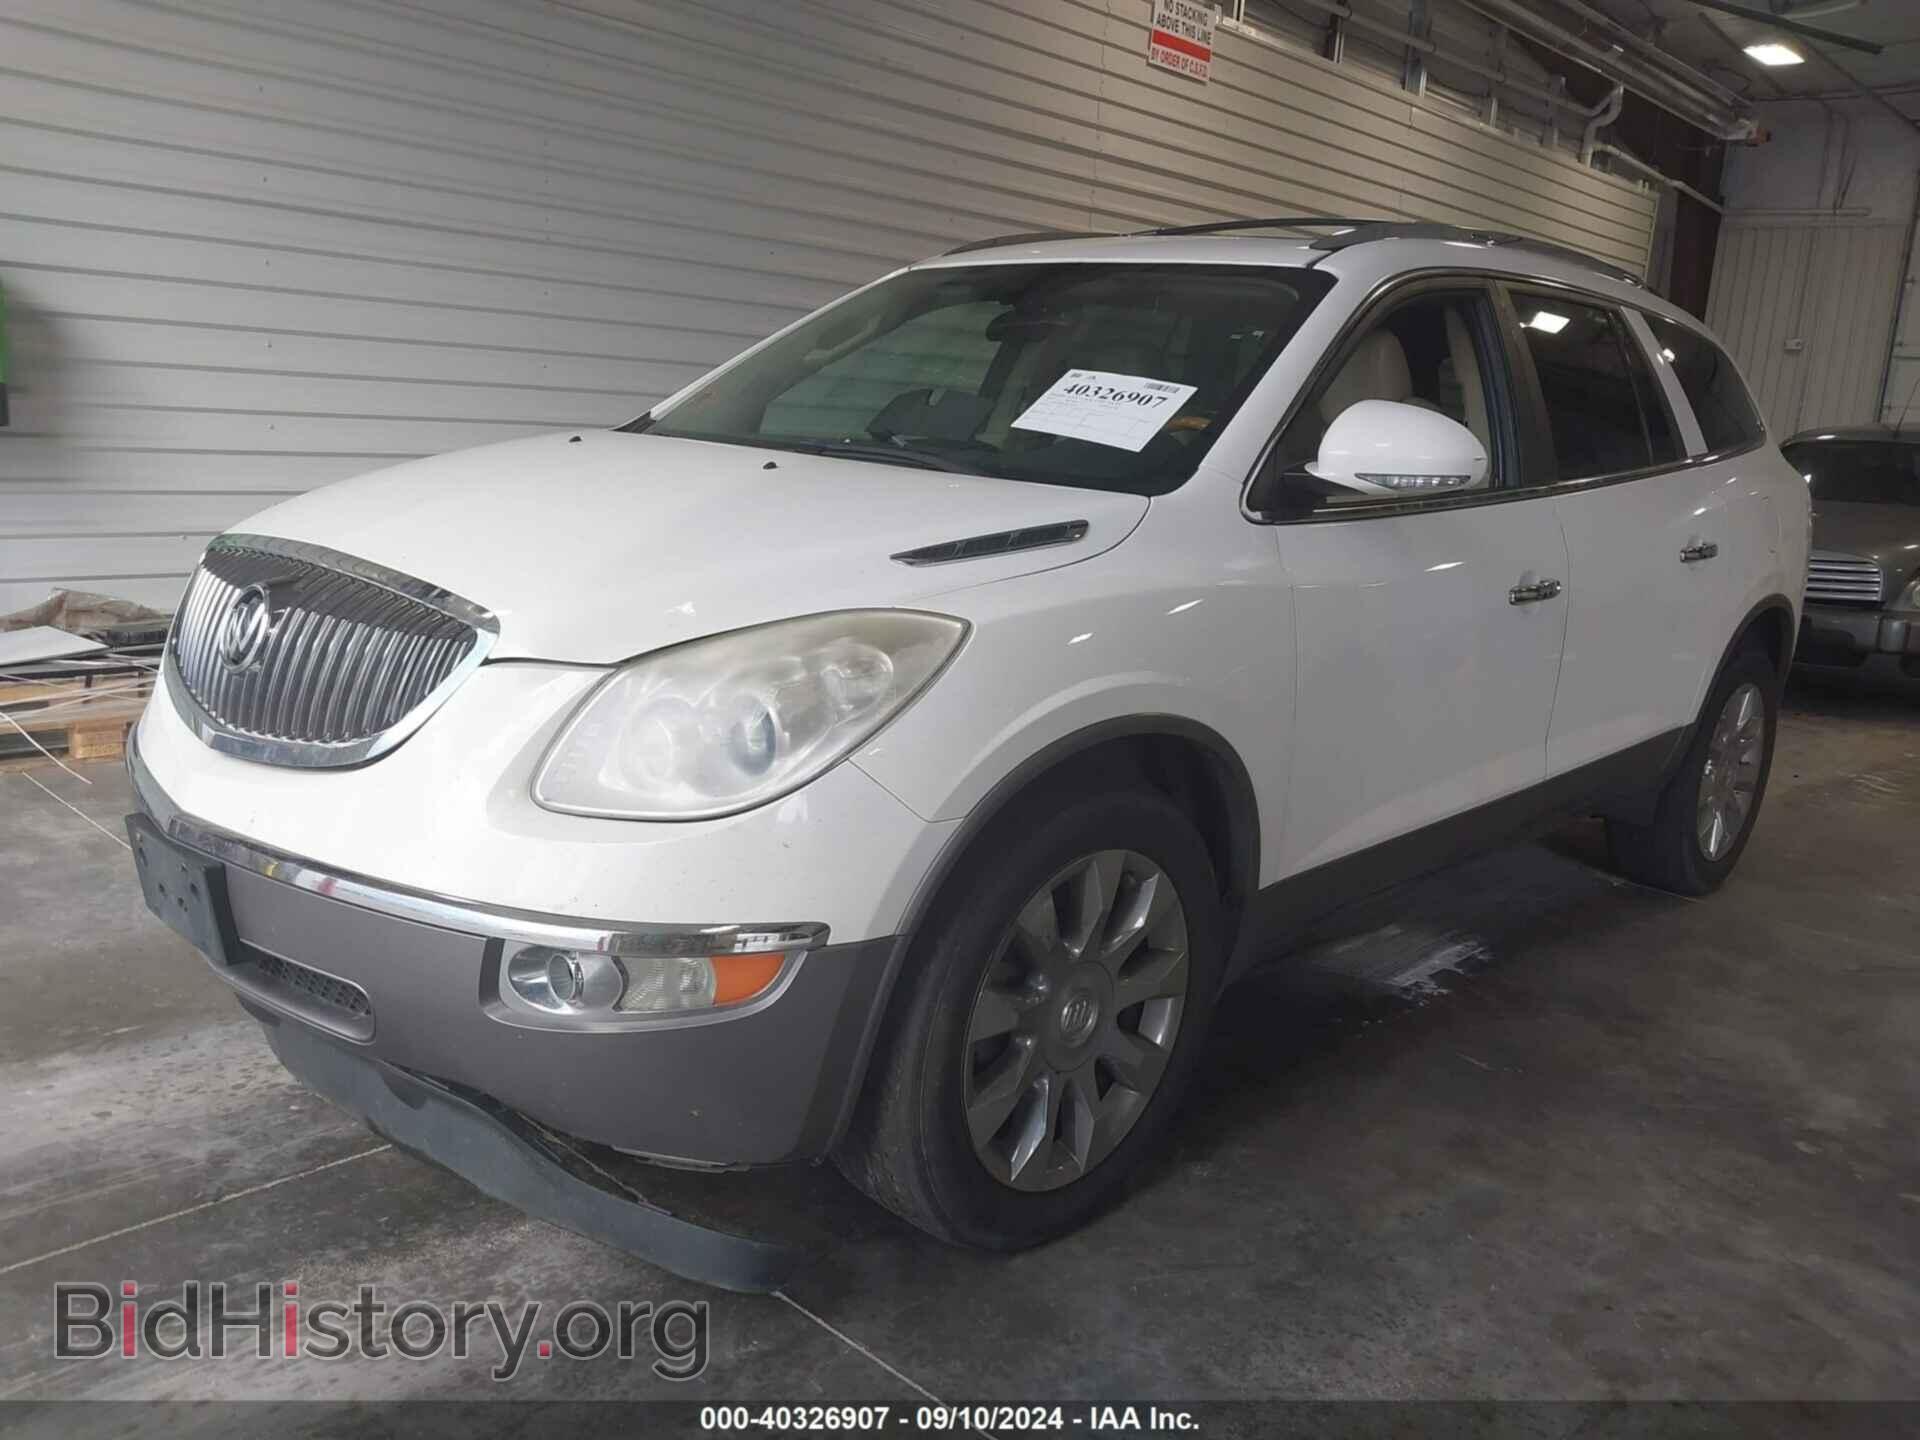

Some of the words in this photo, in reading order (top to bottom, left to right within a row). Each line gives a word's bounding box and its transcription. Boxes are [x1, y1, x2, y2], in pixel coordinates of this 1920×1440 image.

[1175, 2, 1208, 27] STACKING
[1156, 12, 1180, 33] ABOVE
[1182, 21, 1196, 39] THIS
[1196, 27, 1212, 45] LINE
[1063, 383, 1168, 409] 40326907
